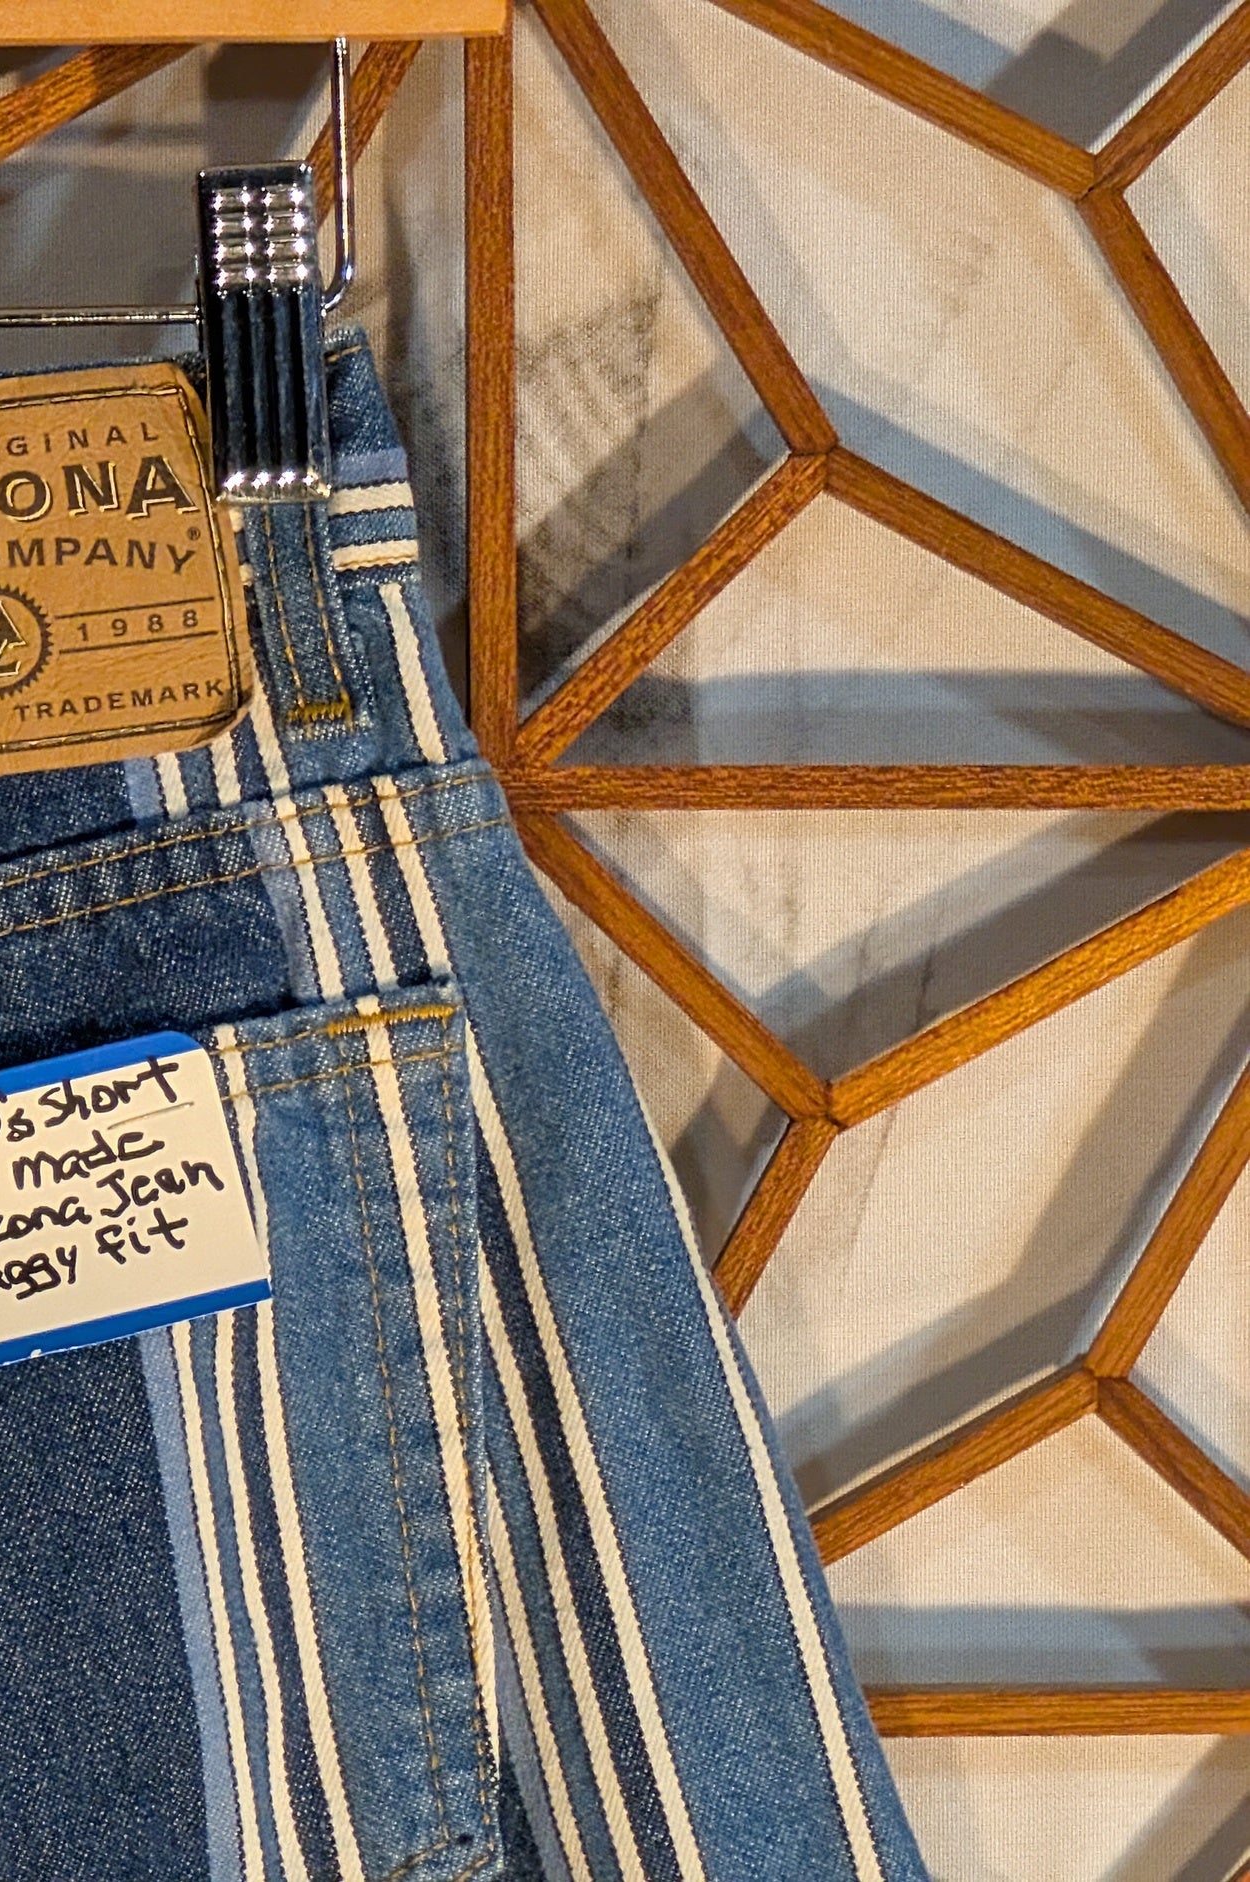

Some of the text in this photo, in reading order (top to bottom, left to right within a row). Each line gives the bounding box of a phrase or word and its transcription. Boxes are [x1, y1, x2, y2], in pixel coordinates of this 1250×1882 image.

[77, 609, 199, 642] 1988
[14, 680, 224, 721] TRADEMARK
[97, 1160, 224, 1218] Jean
